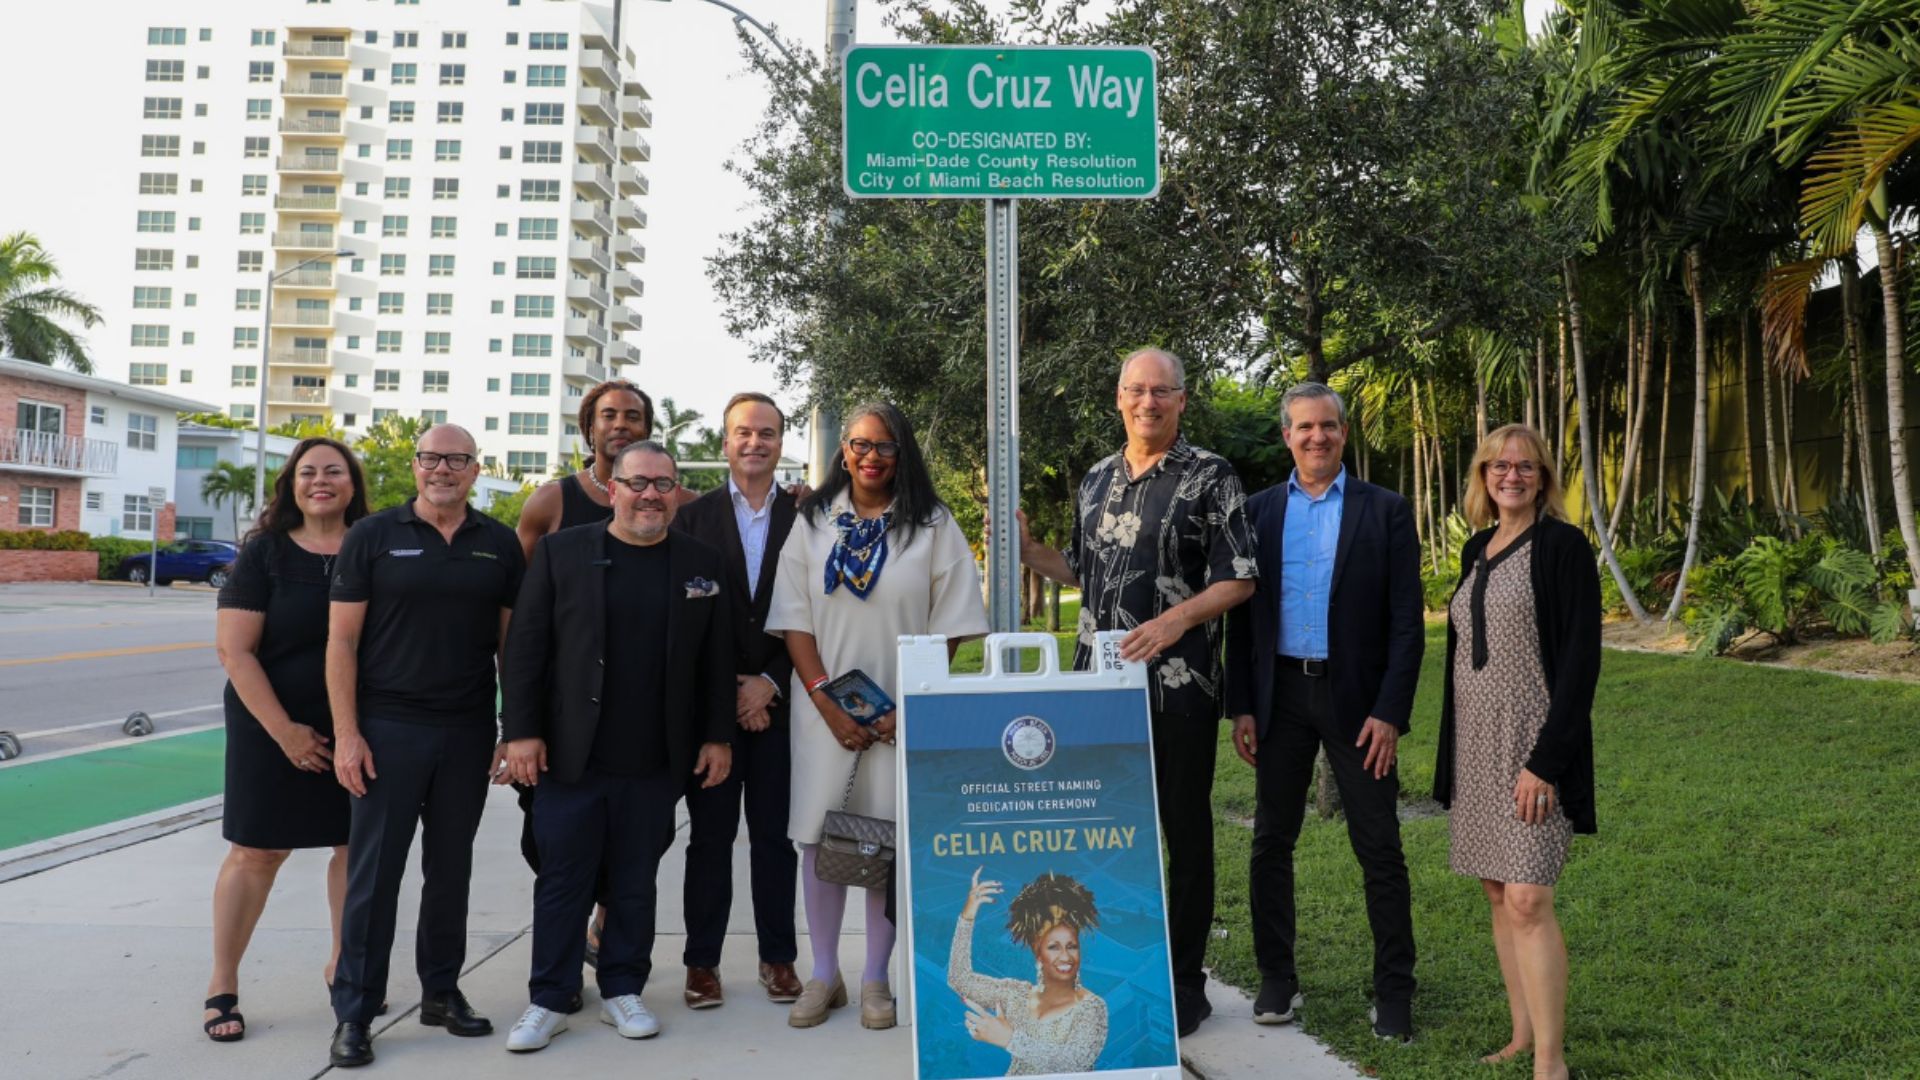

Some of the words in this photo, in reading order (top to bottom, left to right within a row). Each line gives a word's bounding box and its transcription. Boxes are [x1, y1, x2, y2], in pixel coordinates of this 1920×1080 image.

[855, 61, 949, 109] Celia
[967, 62, 1052, 109] Cruz
[1068, 64, 1144, 119] Way
[912, 131, 1057, 149] CO-DESIGNATED
[1064, 132, 1092, 149] BY:
[866, 153, 970, 168] Miami-Dade
[977, 153, 1038, 170] County
[1047, 154, 1137, 168] Resolution
[859, 172, 895, 191] City
[903, 172, 922, 188] of
[929, 172, 981, 188] Miami
[988, 172, 1044, 188] Beach
[1052, 172, 1145, 188] Resolution
[961, 783, 1010, 795] OFFICIAL
[1014, 781, 1054, 793] STREET
[1058, 779, 1102, 791] NAMING
[967, 800, 1034, 813] DEDICATION
[1038, 798, 1097, 811] CEREMONY
[933, 832, 1006, 857] CELIA
[1013, 829, 1077, 854] CRUZ
[1084, 826, 1136, 850] WAY
